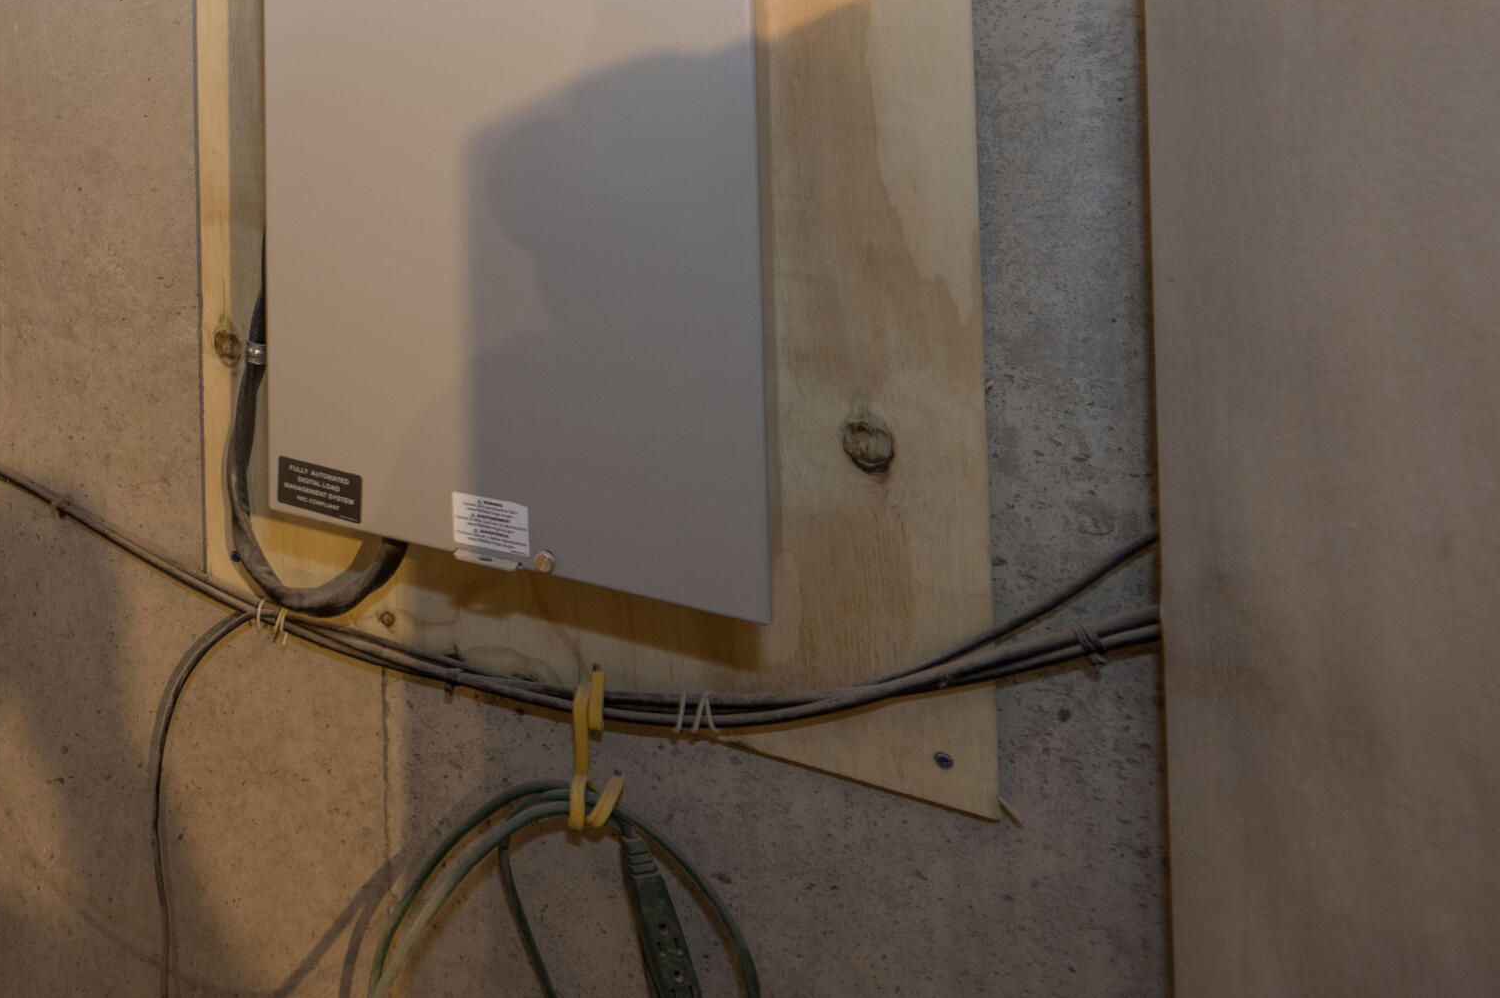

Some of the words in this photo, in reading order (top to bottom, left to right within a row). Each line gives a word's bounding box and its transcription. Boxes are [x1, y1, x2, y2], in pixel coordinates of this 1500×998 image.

[288, 464, 309, 475] FULLY
[310, 470, 350, 486] AUTOMATED
[322, 482, 341, 493] LOAD
